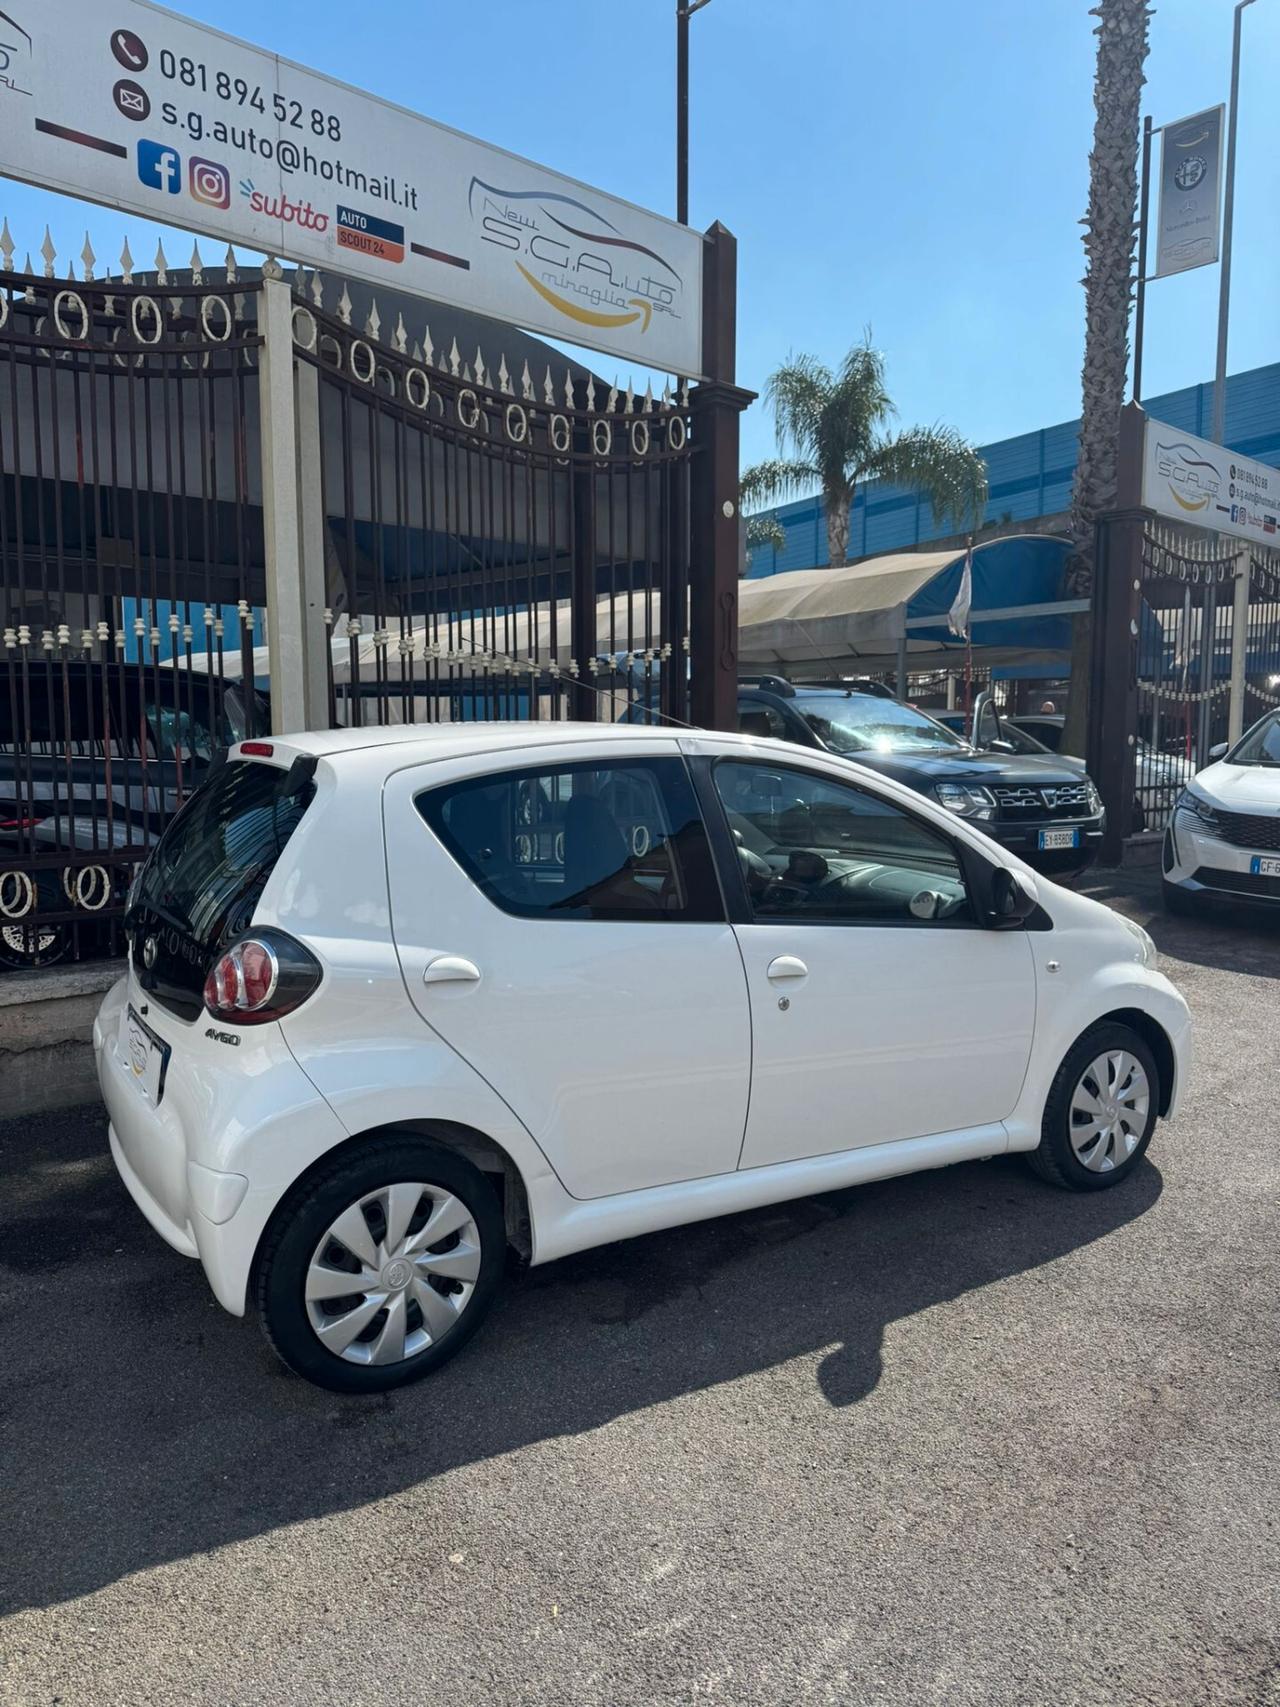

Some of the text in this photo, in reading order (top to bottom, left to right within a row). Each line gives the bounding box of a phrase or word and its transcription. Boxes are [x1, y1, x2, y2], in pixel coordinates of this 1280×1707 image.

[160, 49, 341, 142] 081 894 52 88
[162, 102, 418, 211] s.g.auto@hotmail.it
[250, 191, 329, 232] subito
[340, 210, 367, 229] AUTO
[340, 231, 385, 255] SCOUT 24
[205, 1028, 241, 1046] AYGO
